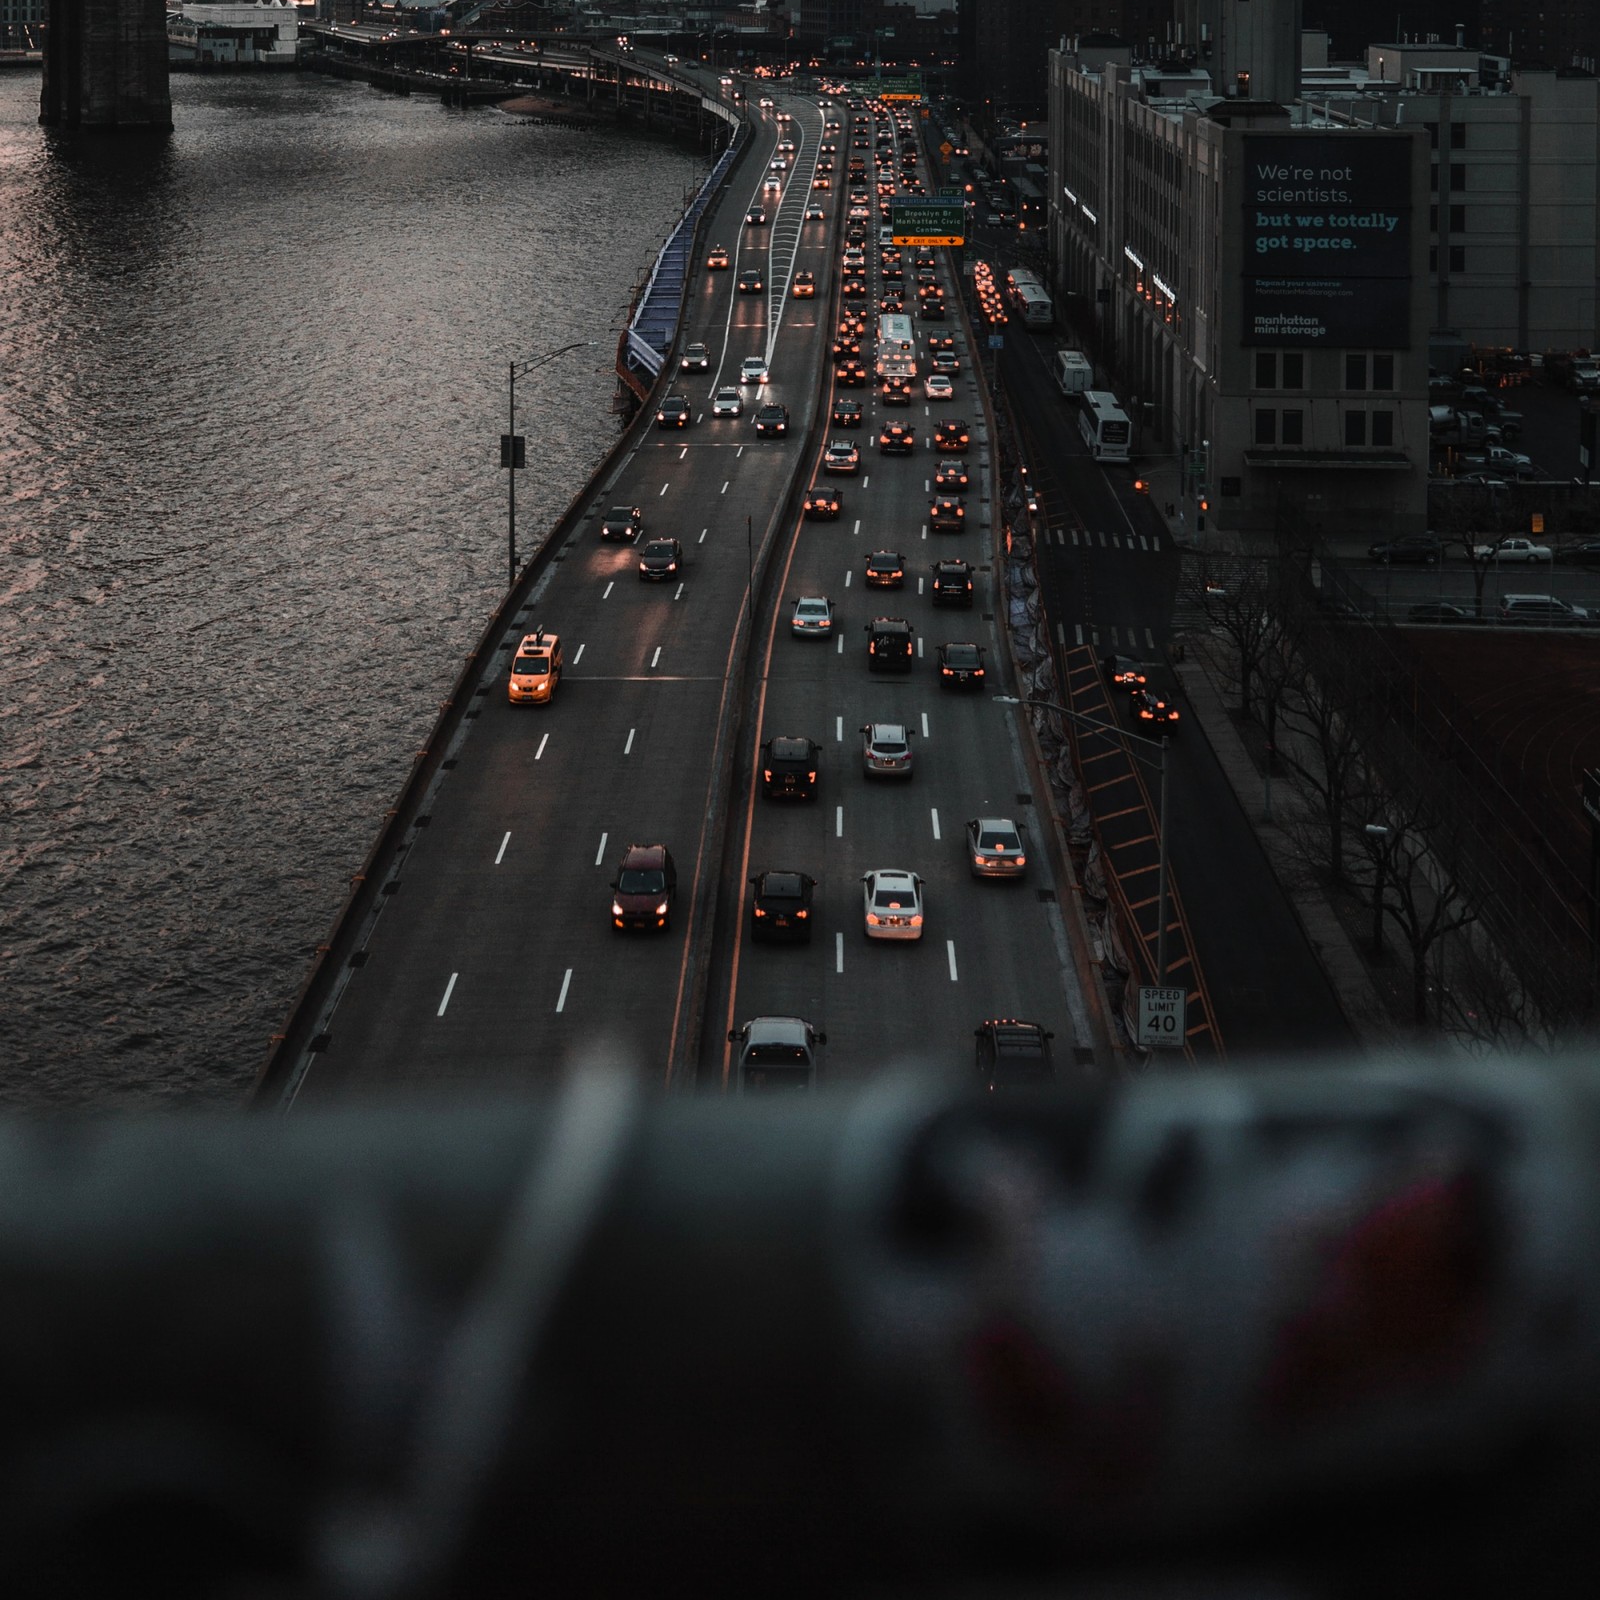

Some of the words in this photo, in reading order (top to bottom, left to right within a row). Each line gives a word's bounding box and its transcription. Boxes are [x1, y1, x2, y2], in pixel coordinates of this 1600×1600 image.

[1257, 164, 1313, 180] We're
[1320, 166, 1352, 180] not
[1257, 187, 1352, 203] scientists,
[1256, 212, 1291, 227] but
[1295, 215, 1324, 227] we
[1328, 212, 1399, 232] totally
[1256, 235, 1289, 253] got
[1293, 236, 1357, 252] space.
[1256, 279, 1286, 287] Expand
[1287, 280, 1306, 288] your
[1255, 313, 1319, 326] manhattan
[1254, 324, 1279, 334] mini
[1281, 325, 1326, 337] storage
[1144, 990, 1180, 1000] SPEED
[1148, 1002, 1176, 1012] LIMIT
[1147, 1015, 1176, 1033] 40
